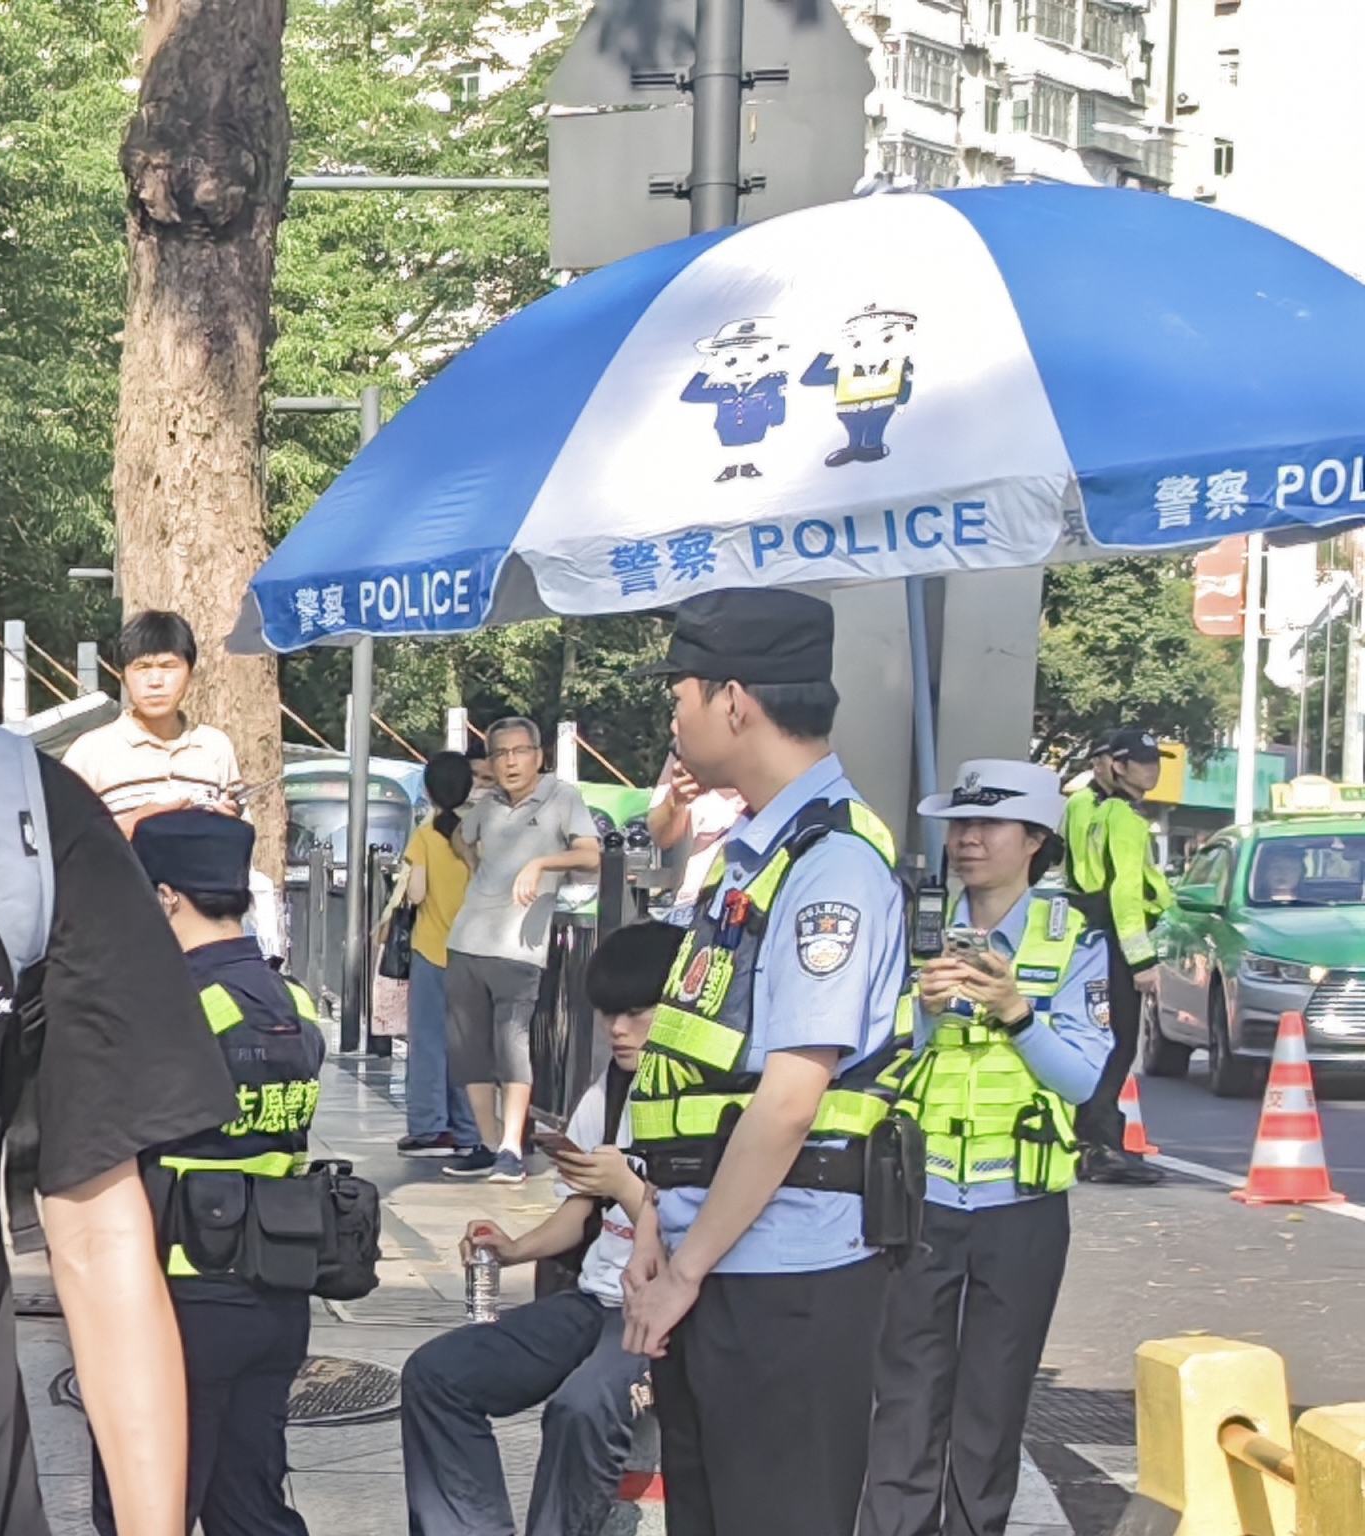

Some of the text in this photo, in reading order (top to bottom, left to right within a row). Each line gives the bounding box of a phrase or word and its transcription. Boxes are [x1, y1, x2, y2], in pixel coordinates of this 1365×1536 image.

[1154, 467, 1250, 530] 警察
[1275, 456, 1365, 510] POL
[609, 529, 718, 597] 警察
[749, 501, 988, 569] POLICE
[294, 569, 472, 636] 警察 POLICE
